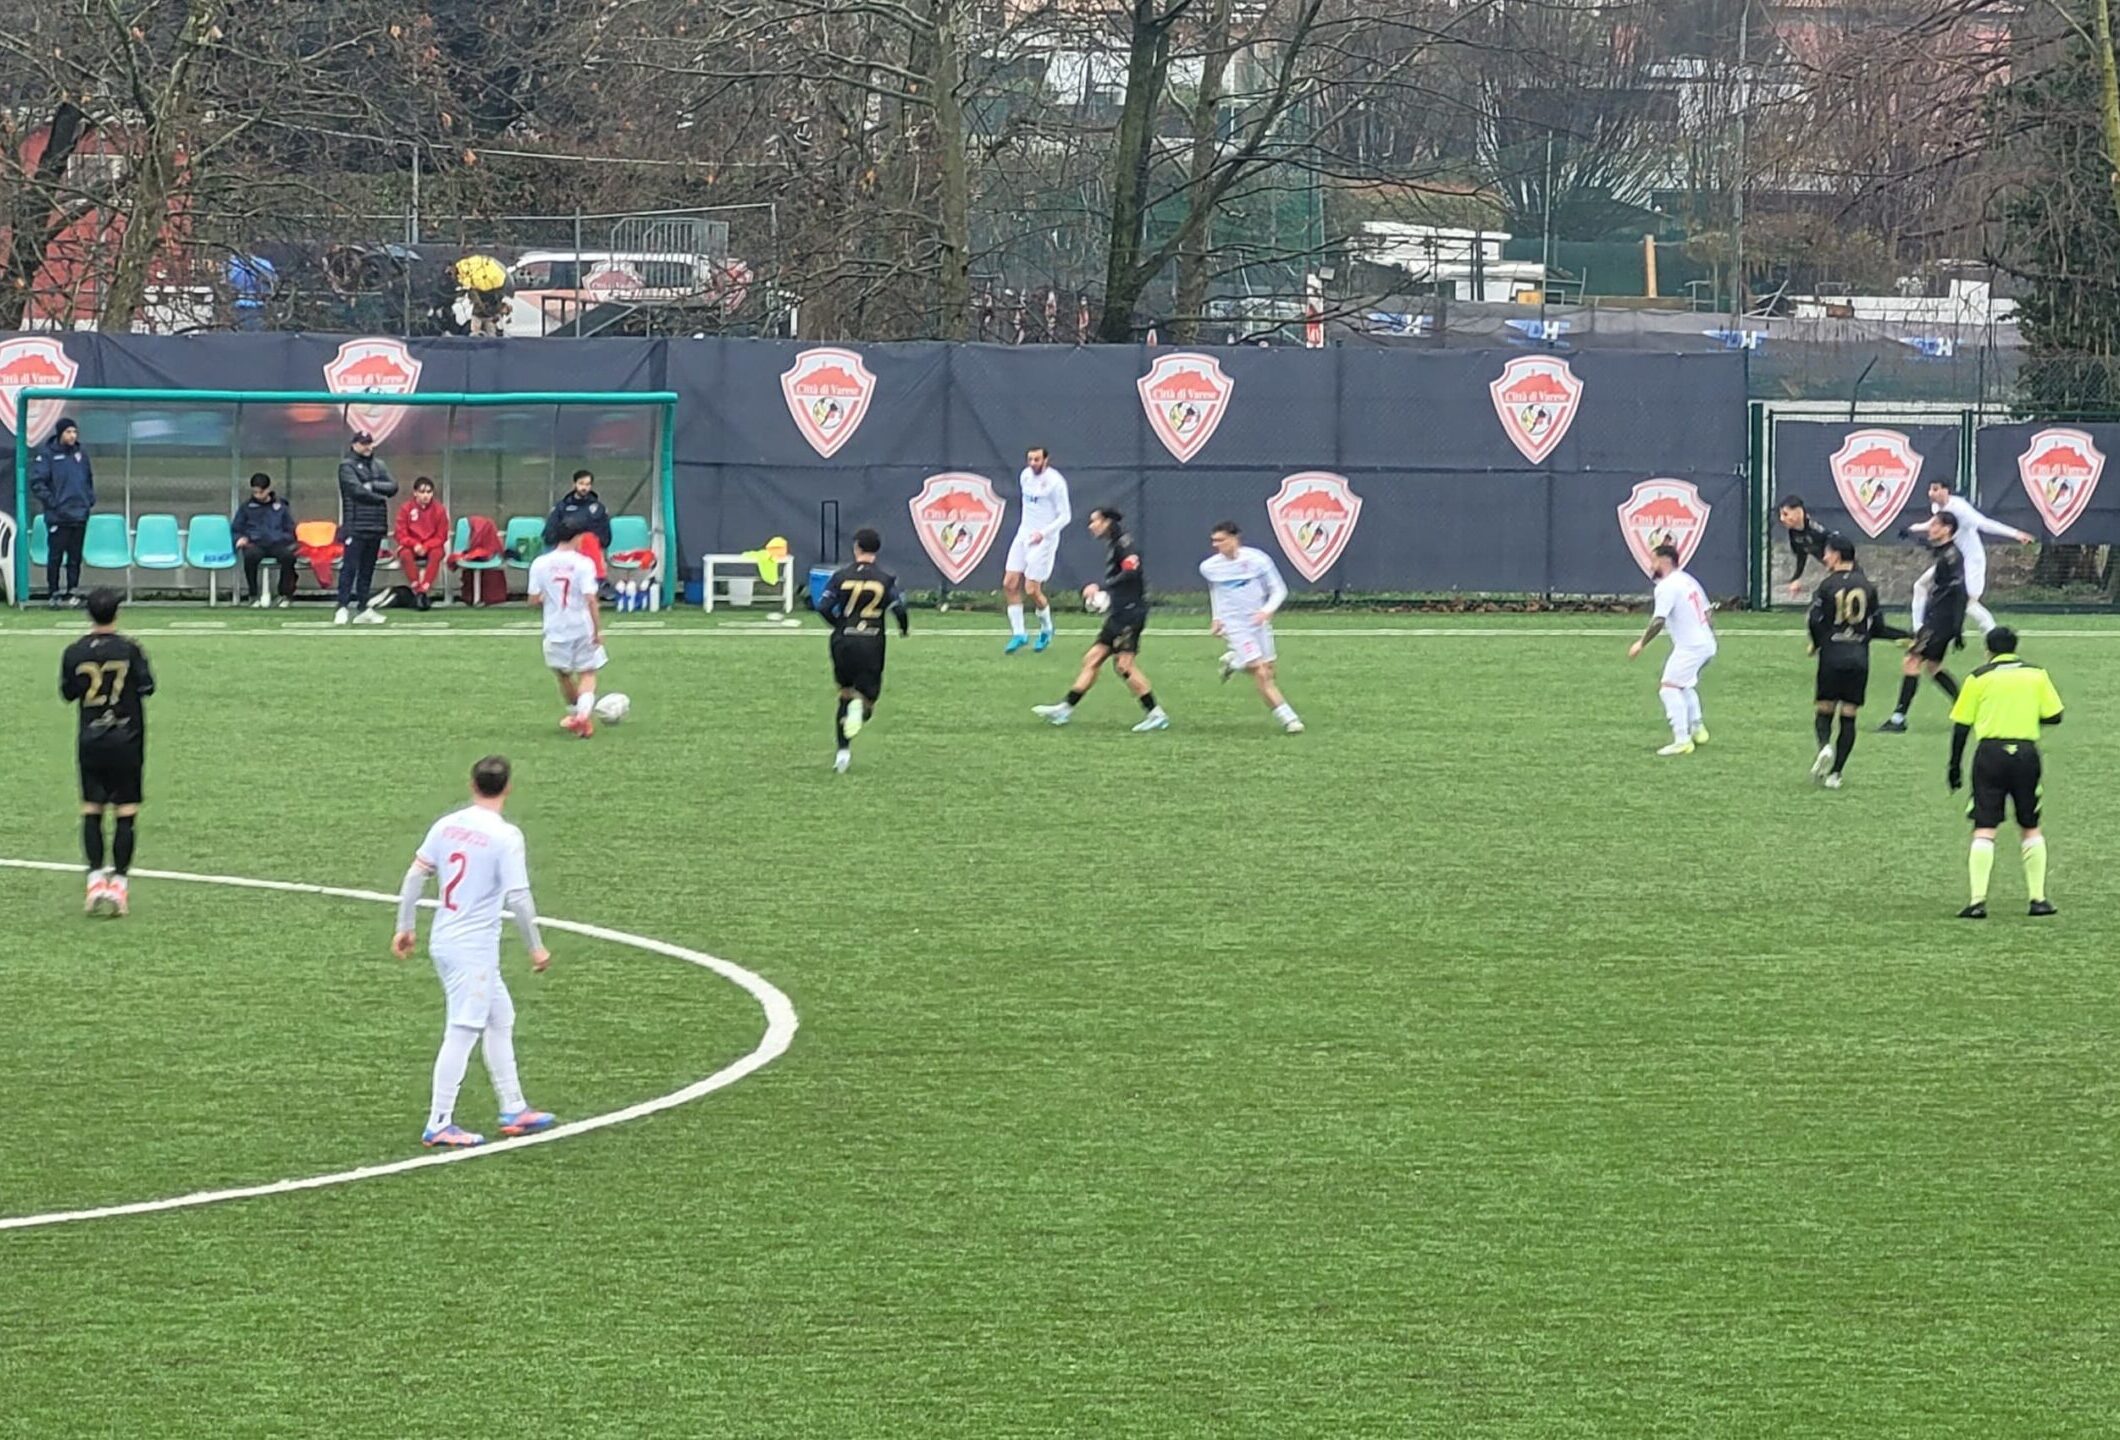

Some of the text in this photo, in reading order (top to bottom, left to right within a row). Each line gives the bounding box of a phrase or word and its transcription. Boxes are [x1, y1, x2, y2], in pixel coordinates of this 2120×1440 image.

[1176, 389, 1186, 400] di
[1528, 391, 1538, 403] di
[551, 577, 571, 609] 7
[839, 580, 885, 619] 72
[1834, 587, 1867, 626] 10
[75, 659, 130, 707] 27
[443, 851, 466, 911] 2
